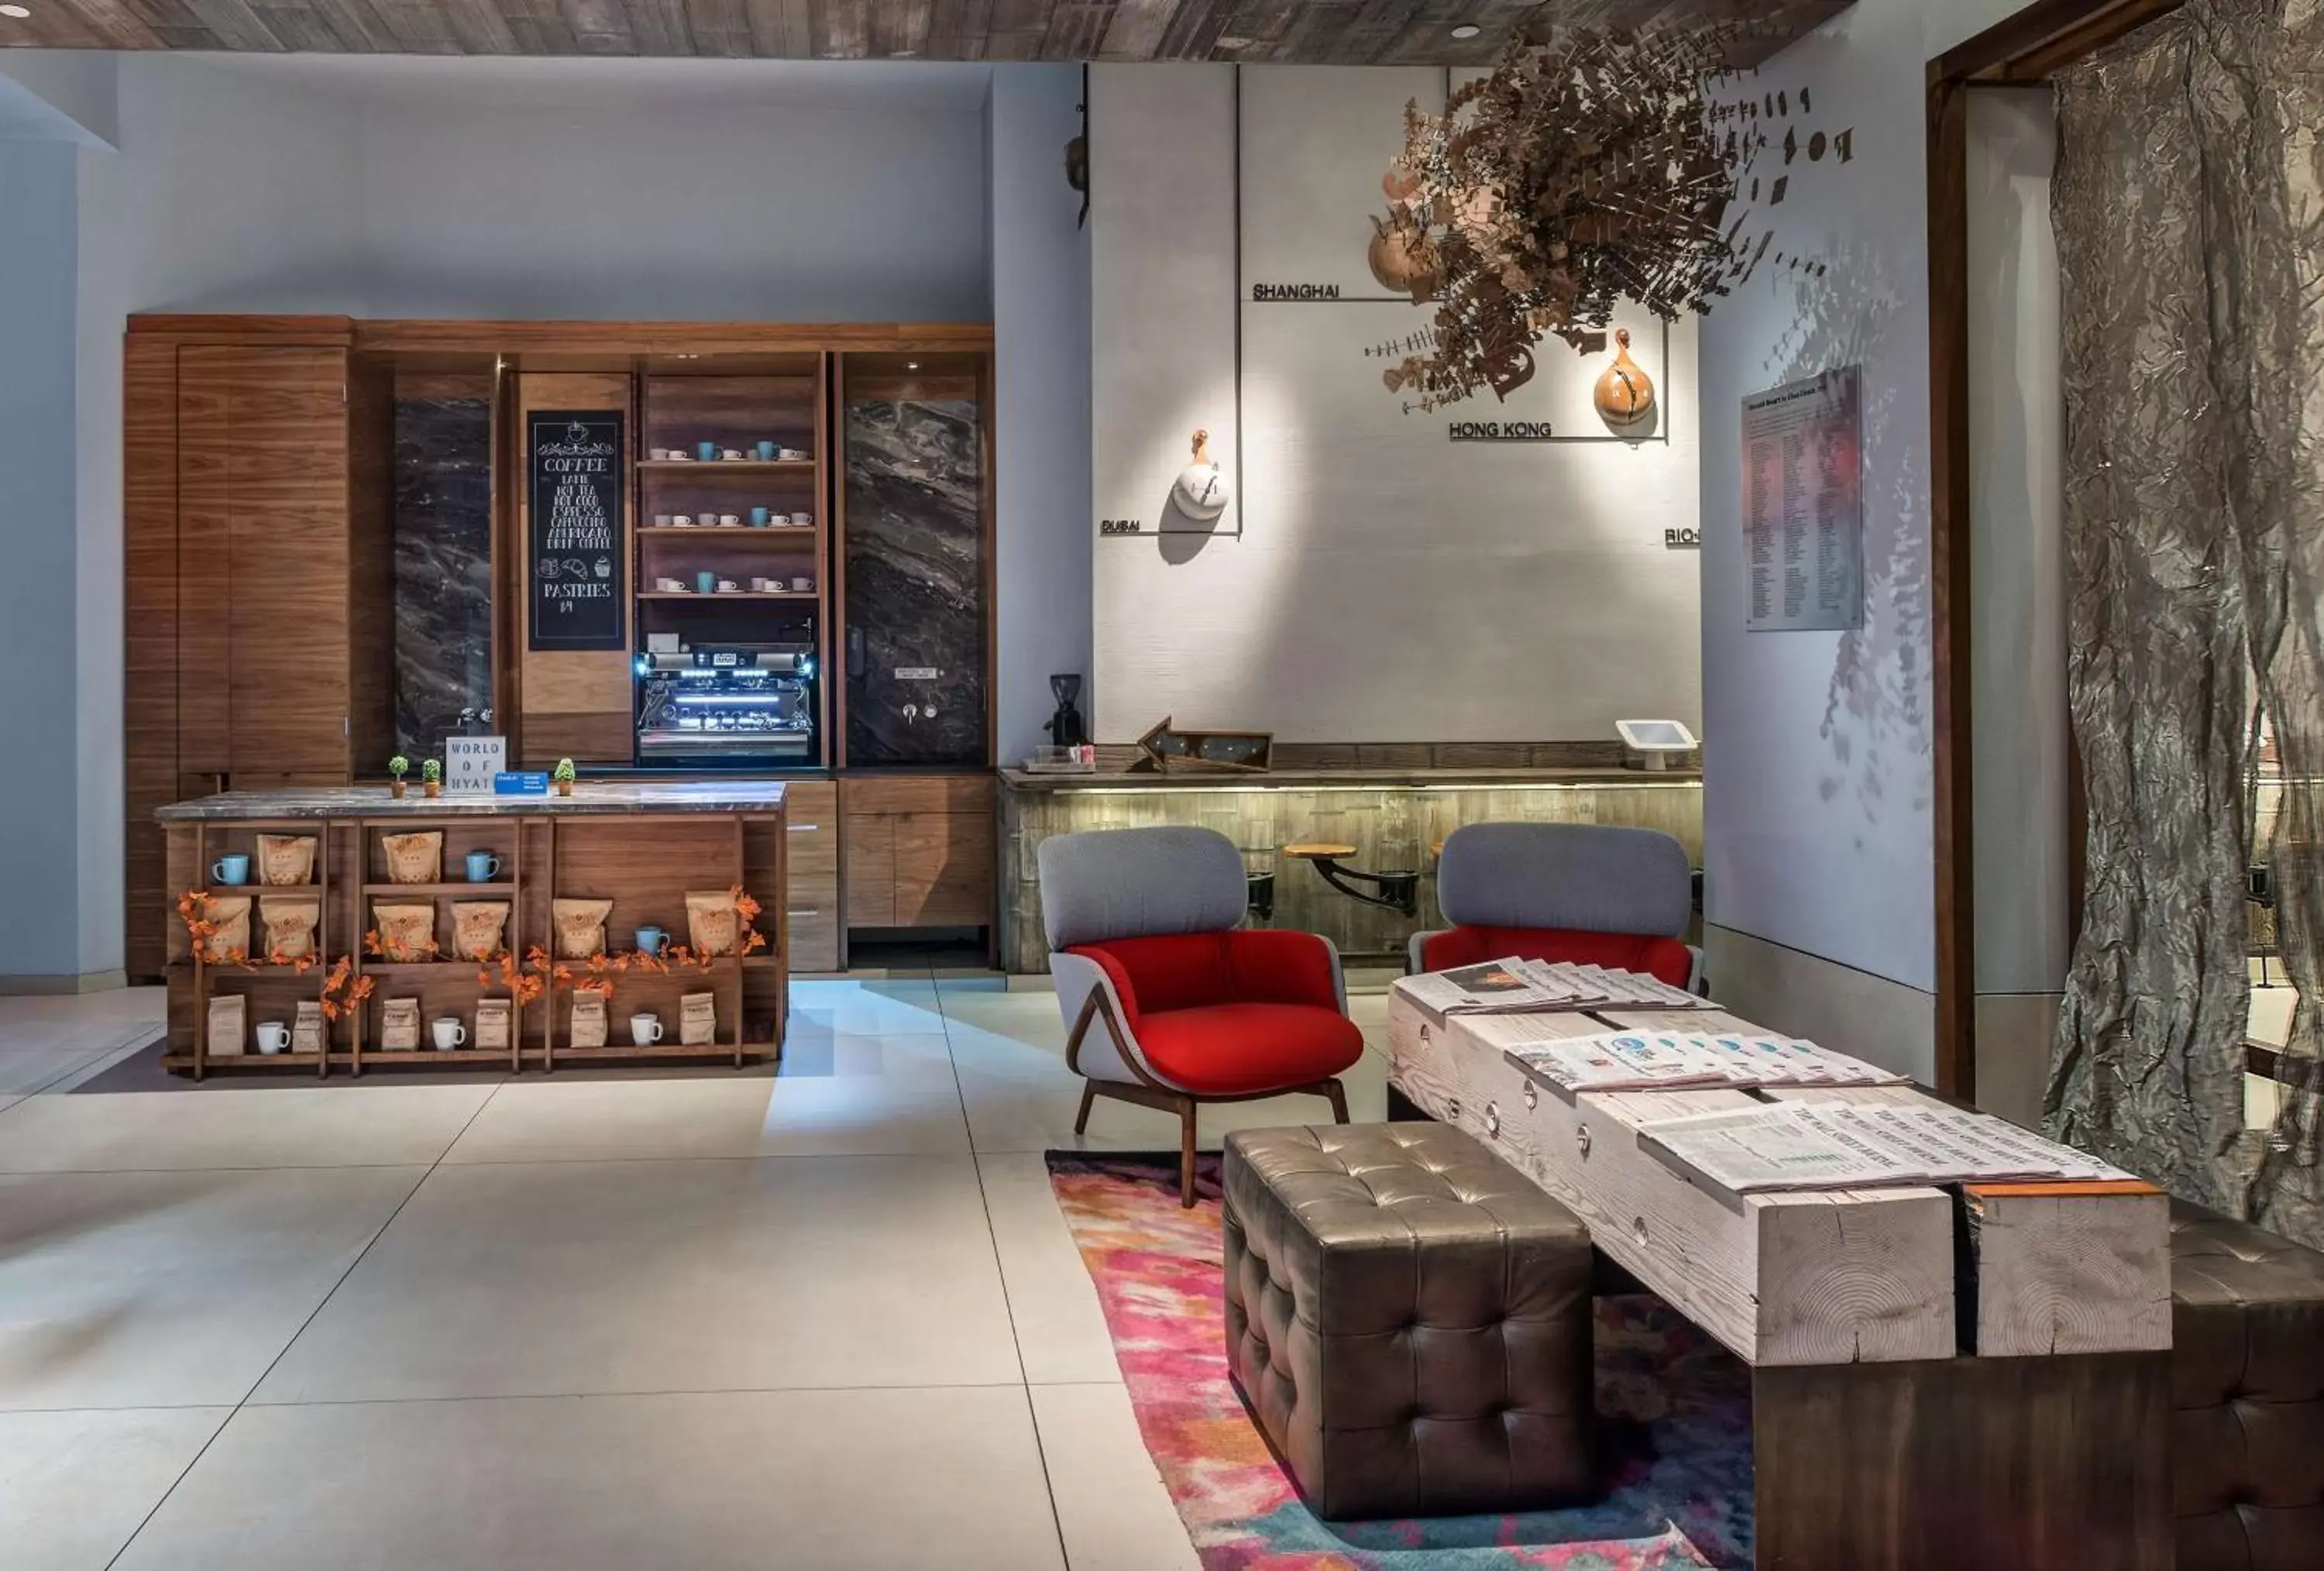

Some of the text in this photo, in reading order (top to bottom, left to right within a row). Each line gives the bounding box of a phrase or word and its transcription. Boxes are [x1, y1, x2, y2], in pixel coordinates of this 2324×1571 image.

[1253, 284, 1339, 298] SHANGHAI
[1449, 422, 1552, 436] HONG KONG
[545, 458, 607, 472] COFFEE
[562, 474, 590, 484] LATTE
[557, 484, 596, 497] HOT TEA
[554, 496, 572, 507] HOT
[552, 505, 604, 517] ESPRESSO
[1102, 520, 1140, 531] DUBAI
[548, 527, 611, 538] AMERICANO
[545, 583, 610, 597] PASTRIES
[452, 743, 499, 754] WORLD
[462, 760, 492, 772] OF
